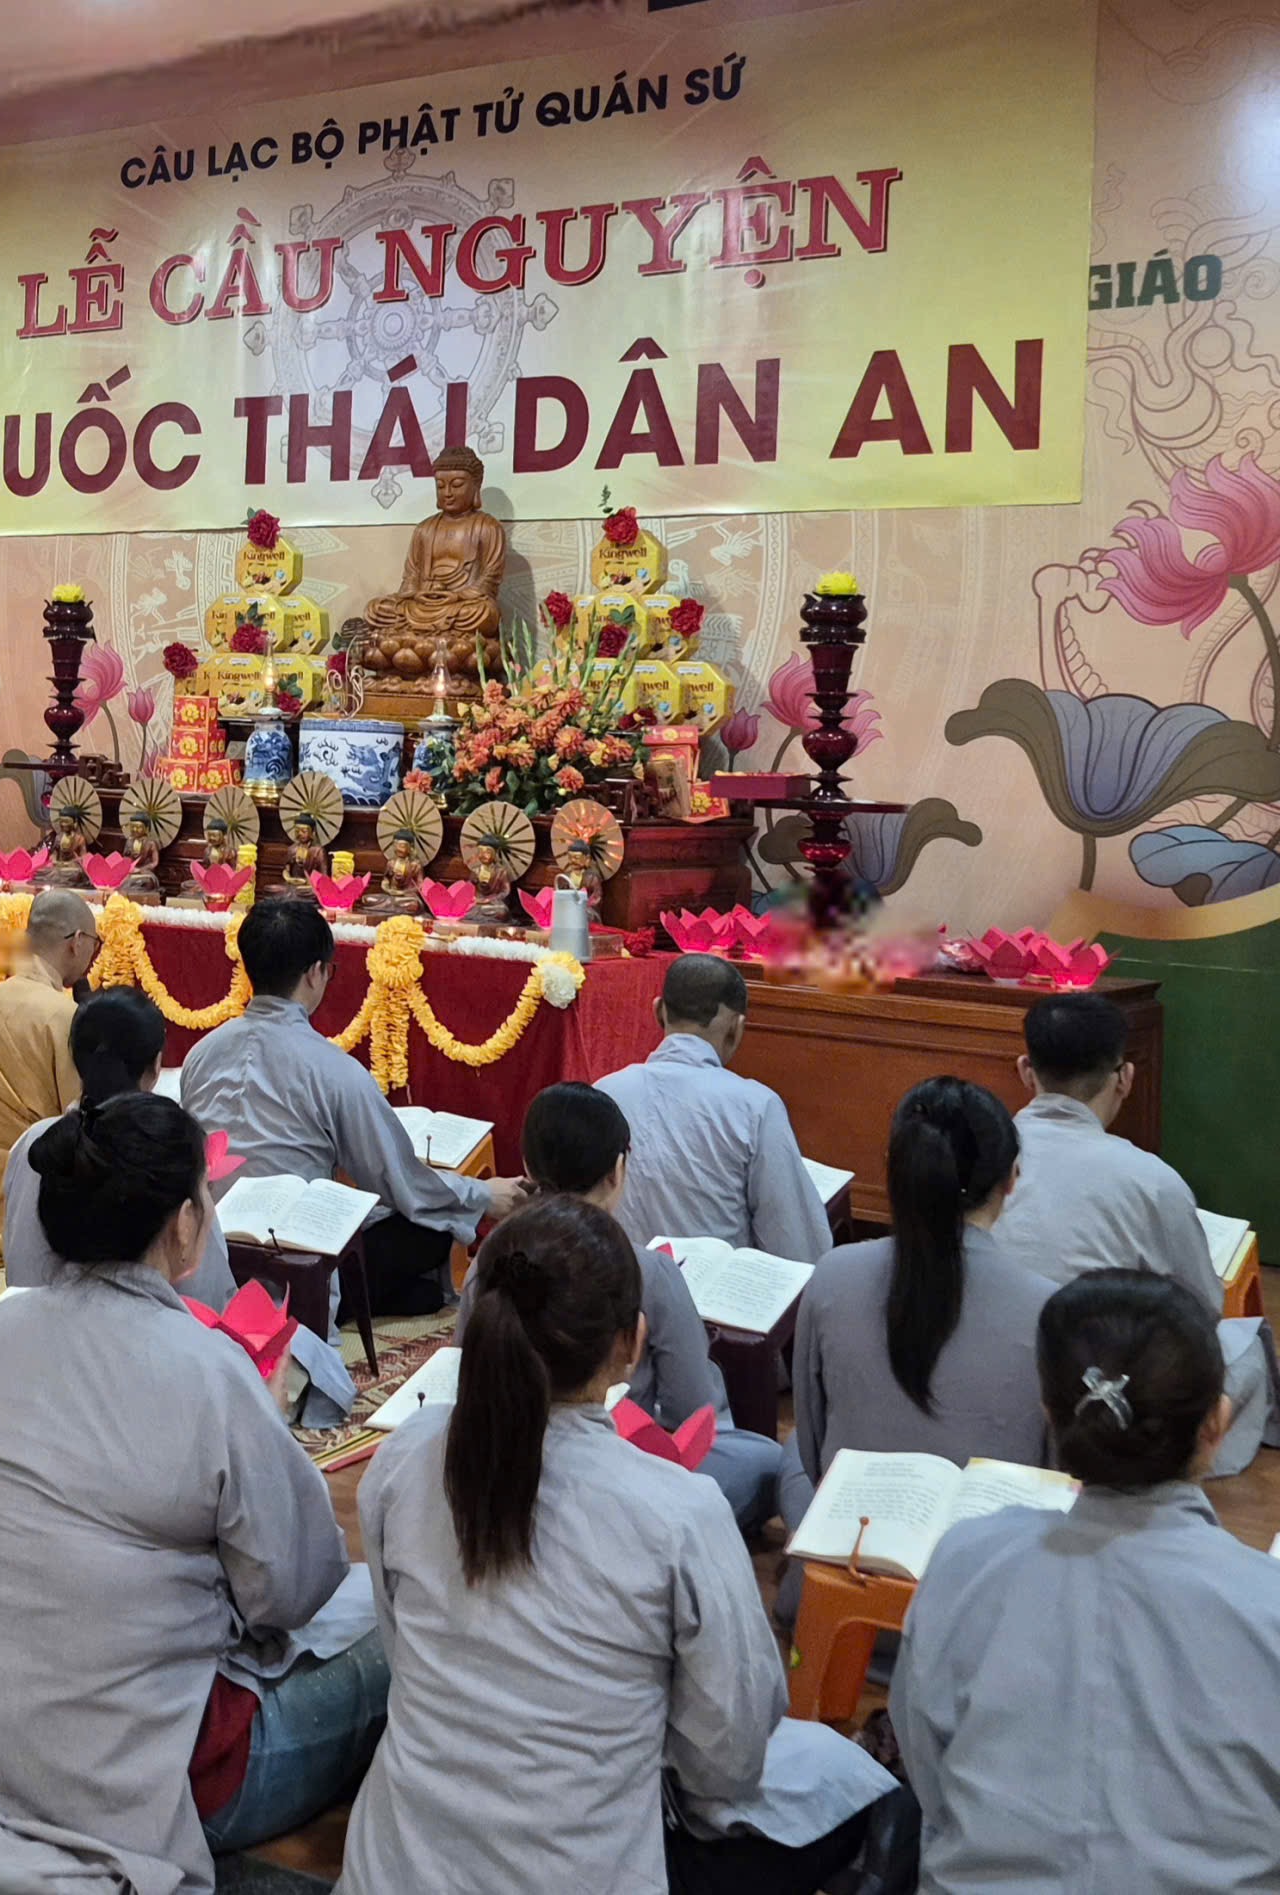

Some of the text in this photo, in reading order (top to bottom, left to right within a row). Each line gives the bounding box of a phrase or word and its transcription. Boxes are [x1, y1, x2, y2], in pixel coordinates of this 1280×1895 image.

[120, 52, 746, 188] CÂU LẠC BỘ PHẬT TỬ QUÁN SỨ
[16, 155, 903, 340] LỄ CẦU NGUYỆN
[233, 353, 469, 485] THÁI
[513, 337, 780, 473] DÂN
[829, 338, 1044, 459] AN
